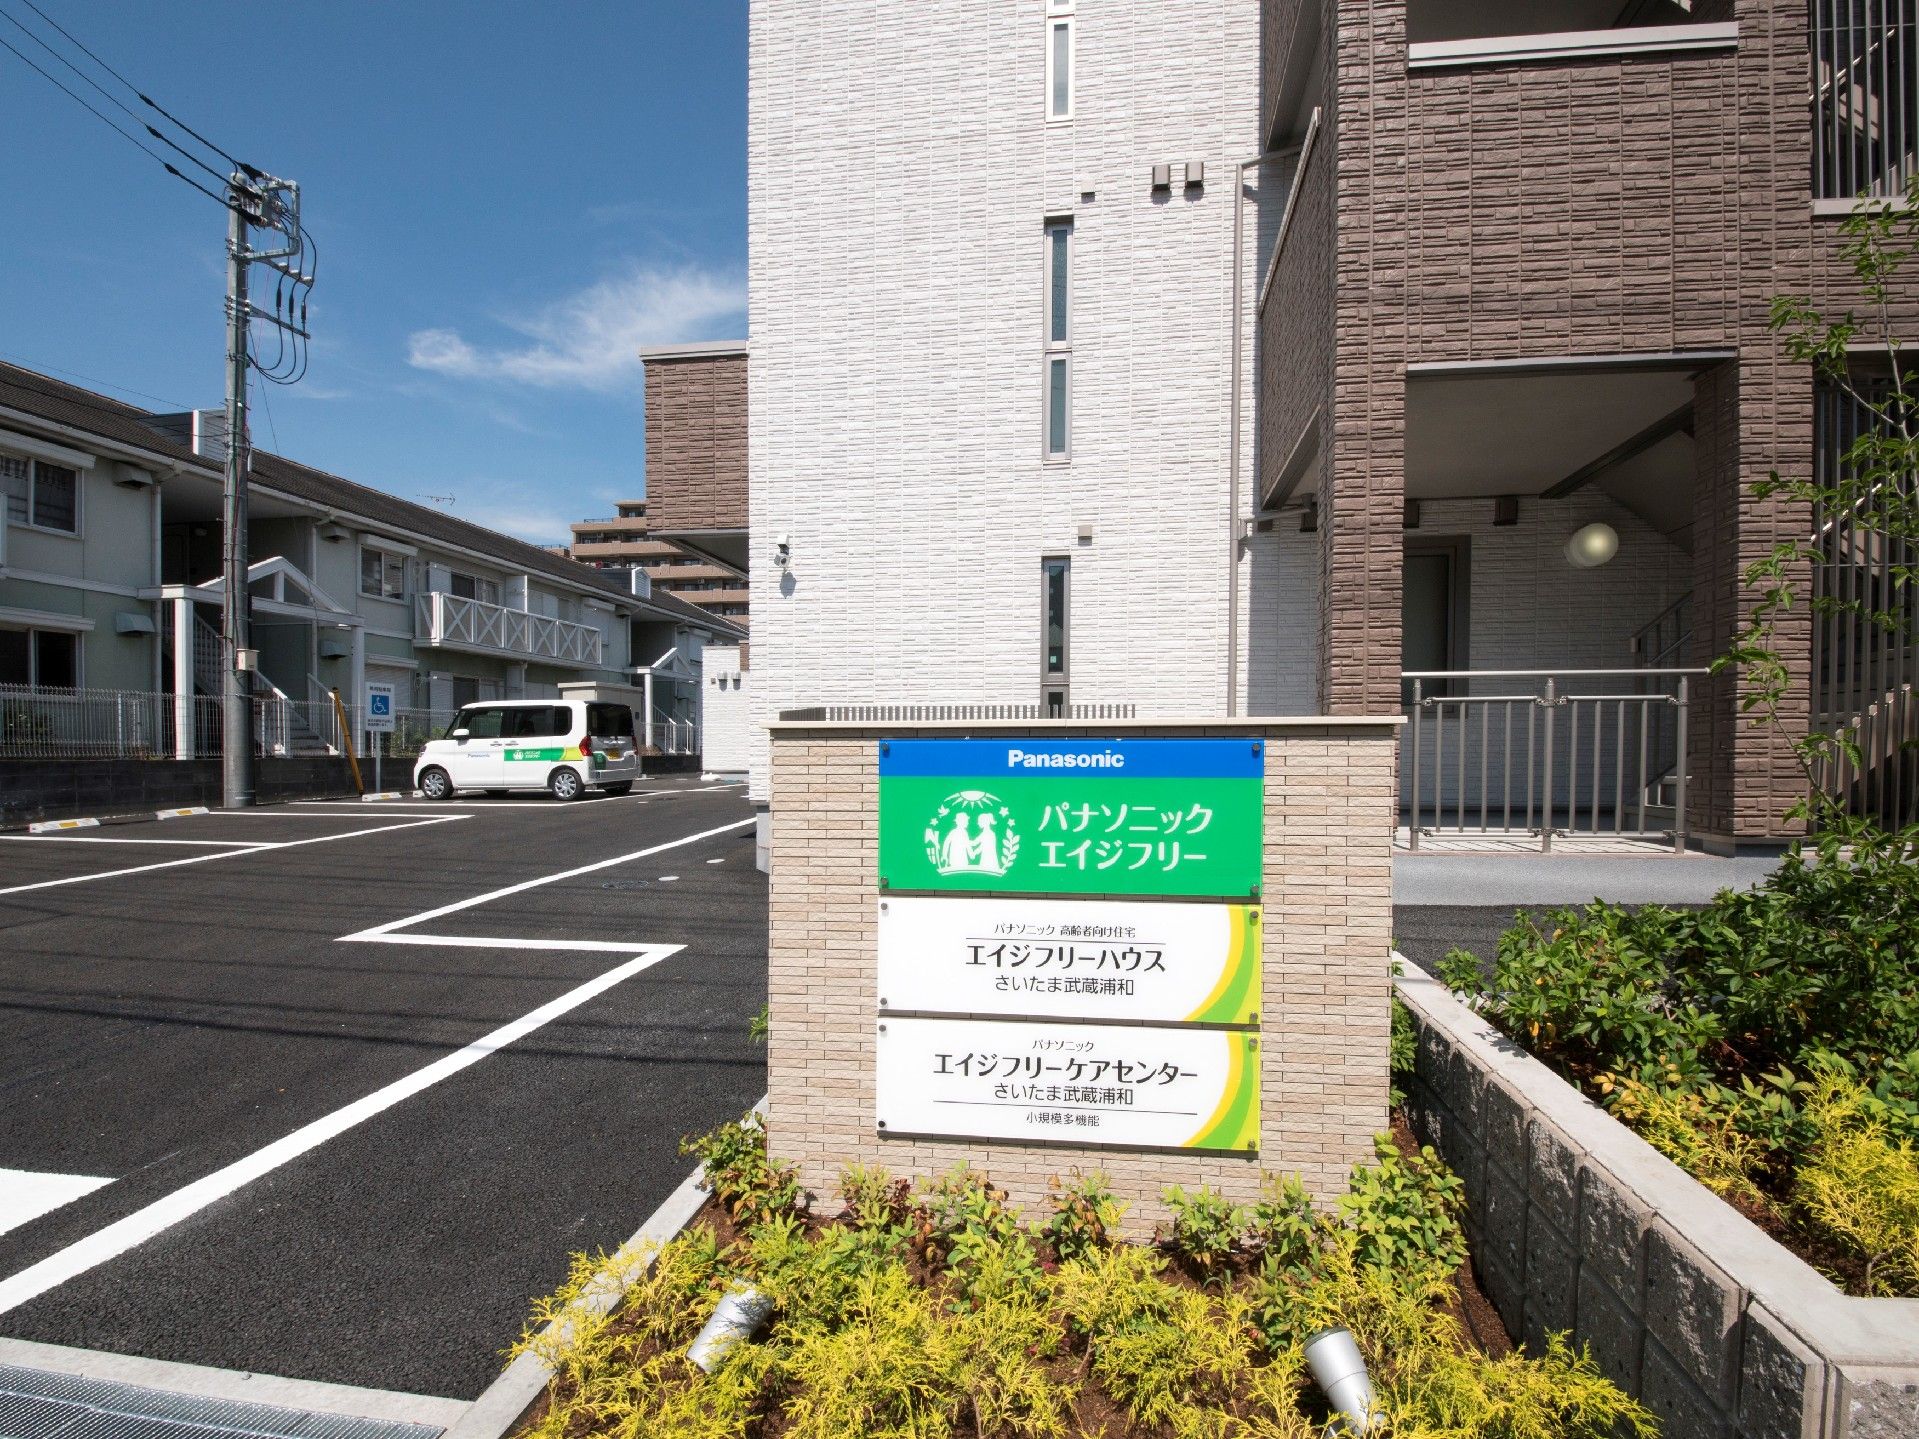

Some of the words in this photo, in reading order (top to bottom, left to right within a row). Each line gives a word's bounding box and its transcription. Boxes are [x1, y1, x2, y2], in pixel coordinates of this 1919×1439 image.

[1007, 749, 1125, 768] Panasonic
[1038, 801, 1213, 834] パナソニック
[1038, 839, 1207, 871] エイジフリー
[994, 923, 1055, 935] パナソニック
[1060, 925, 1136, 938] 高齢者向け住宅
[965, 943, 1166, 972] エイジフリーハウス
[995, 975, 1134, 996] さいたま武蔵浦和
[1032, 1039, 1094, 1052] パナソニック
[933, 1052, 1198, 1086] エイジフリーケアセンター
[994, 1082, 1134, 1105] さいたま武蔵浦和
[1026, 1112, 1100, 1127] 小規模多機能
